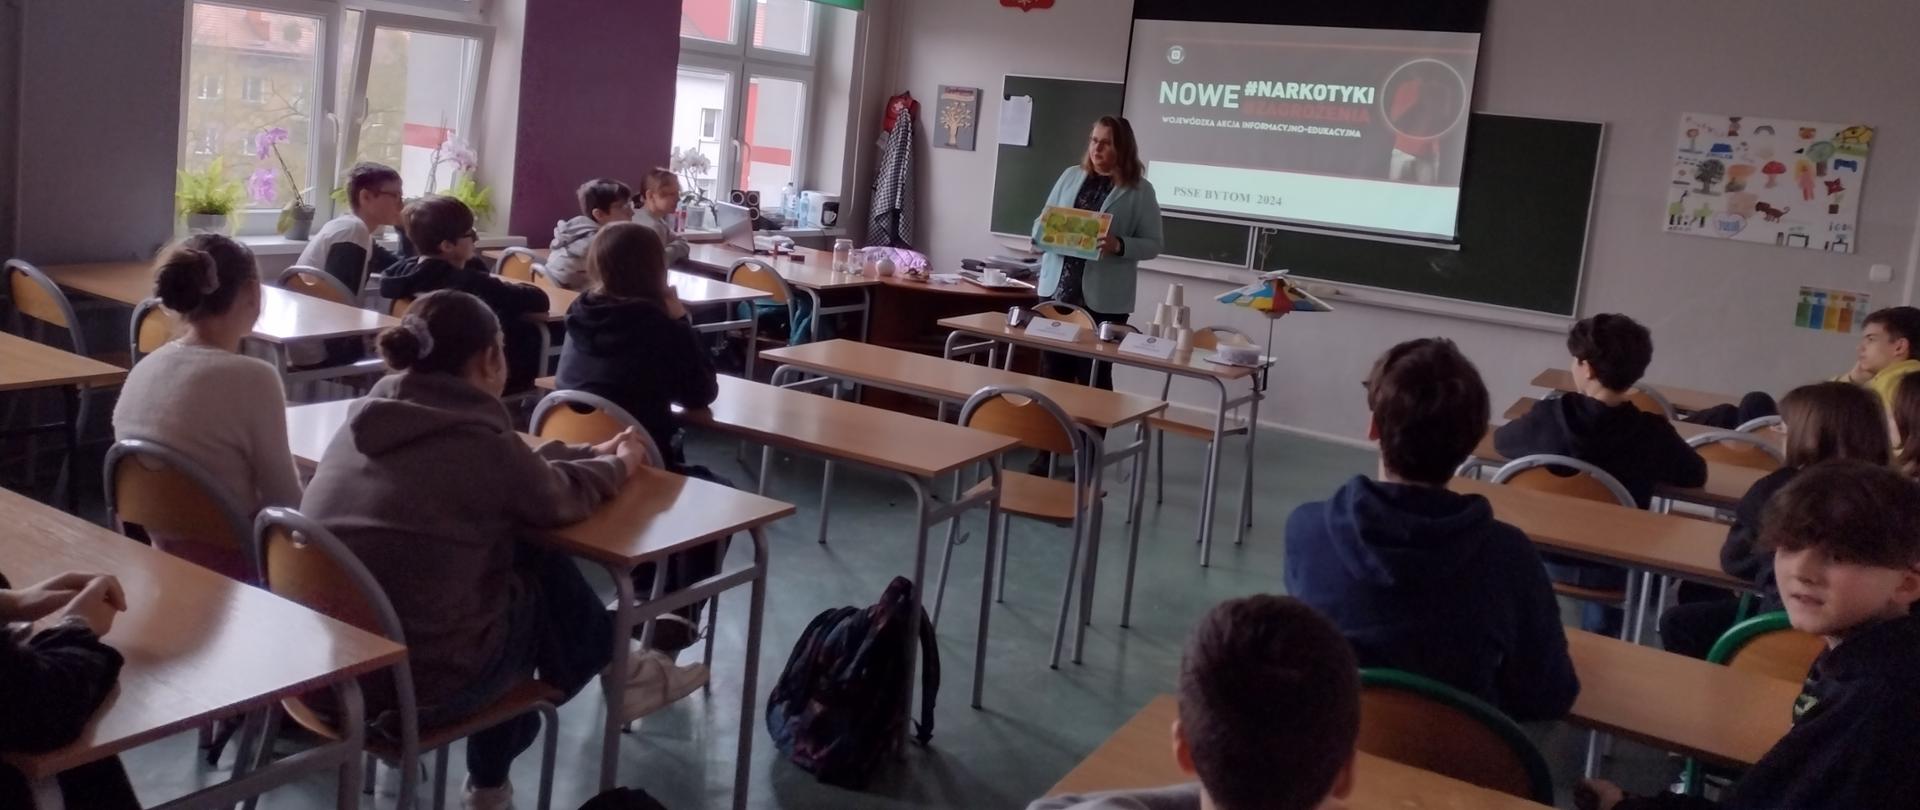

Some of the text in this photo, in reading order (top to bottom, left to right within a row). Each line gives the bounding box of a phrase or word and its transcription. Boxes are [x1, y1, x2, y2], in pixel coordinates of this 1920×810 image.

[1159, 81, 1241, 108] NOWE
[1244, 81, 1375, 104] #NARKOTYKI
[1173, 186, 1282, 206] PSSE BYTOM 2024
